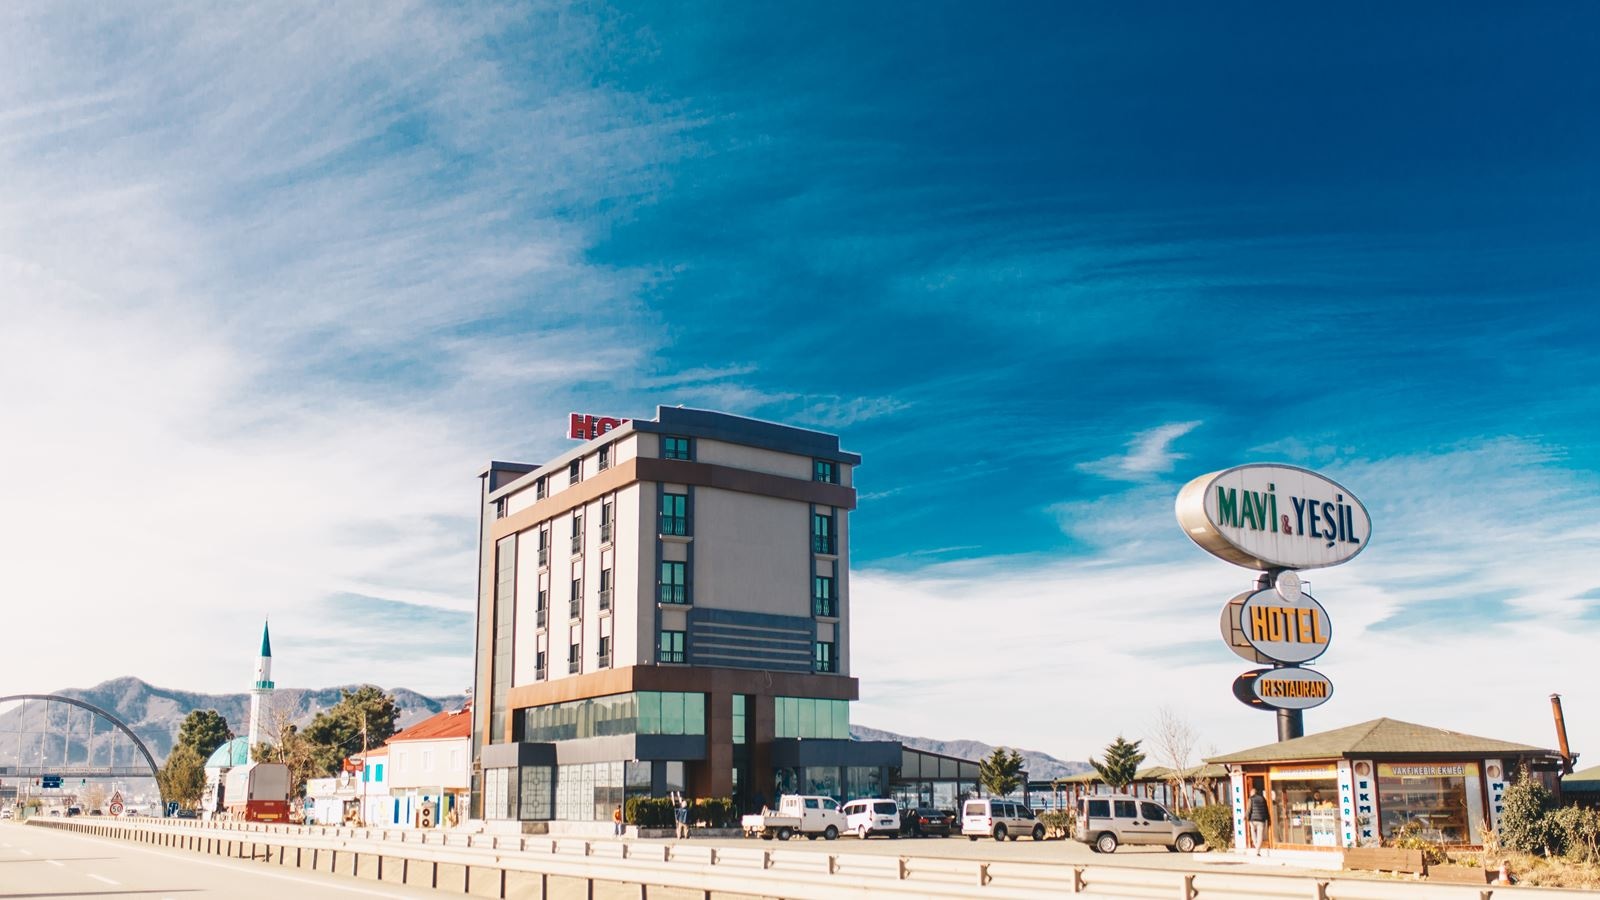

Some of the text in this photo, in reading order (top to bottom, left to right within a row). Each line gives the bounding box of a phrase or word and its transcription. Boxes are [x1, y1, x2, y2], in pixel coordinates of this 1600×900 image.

[569, 412, 632, 440] HO
[1216, 482, 1360, 548] MAVİ & YEŞİL
[1249, 605, 1327, 644] HOTEL
[1260, 679, 1328, 698] RESTAURANT
